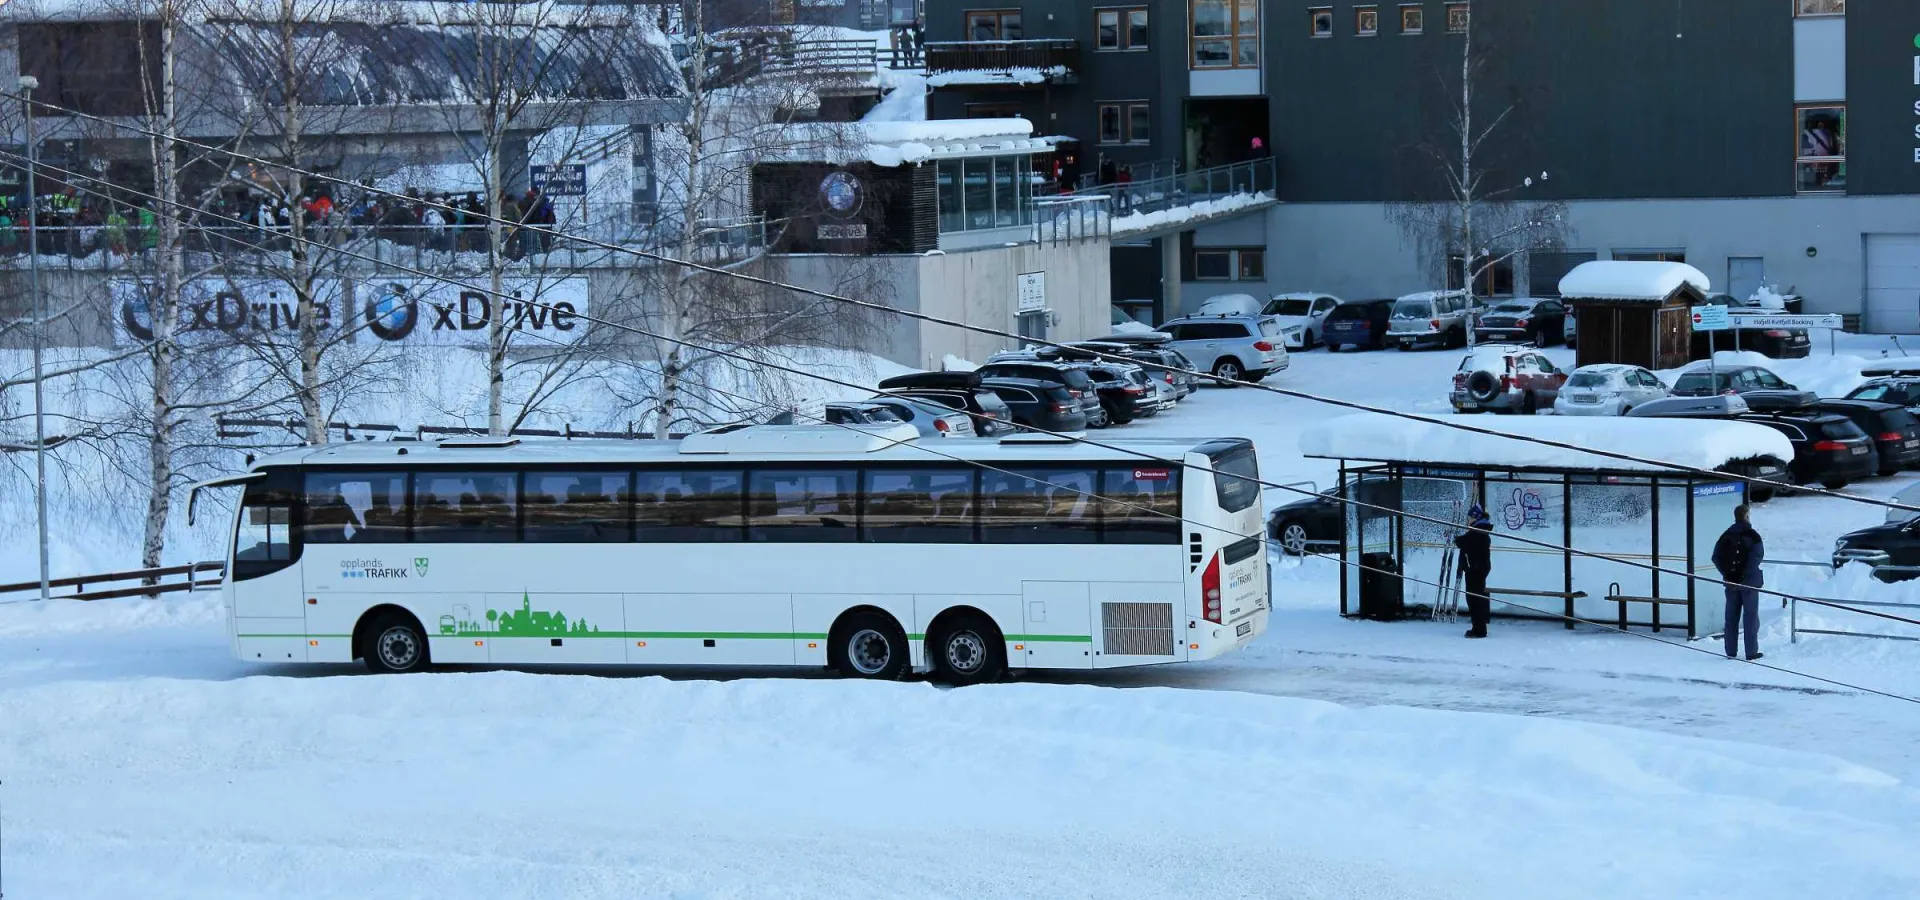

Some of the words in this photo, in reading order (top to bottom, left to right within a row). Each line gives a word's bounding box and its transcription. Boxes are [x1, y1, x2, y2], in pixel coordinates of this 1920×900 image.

[432, 291, 576, 331] xDrive
[340, 558, 382, 569] opplands
[364, 568, 408, 578] TRAFIKK
